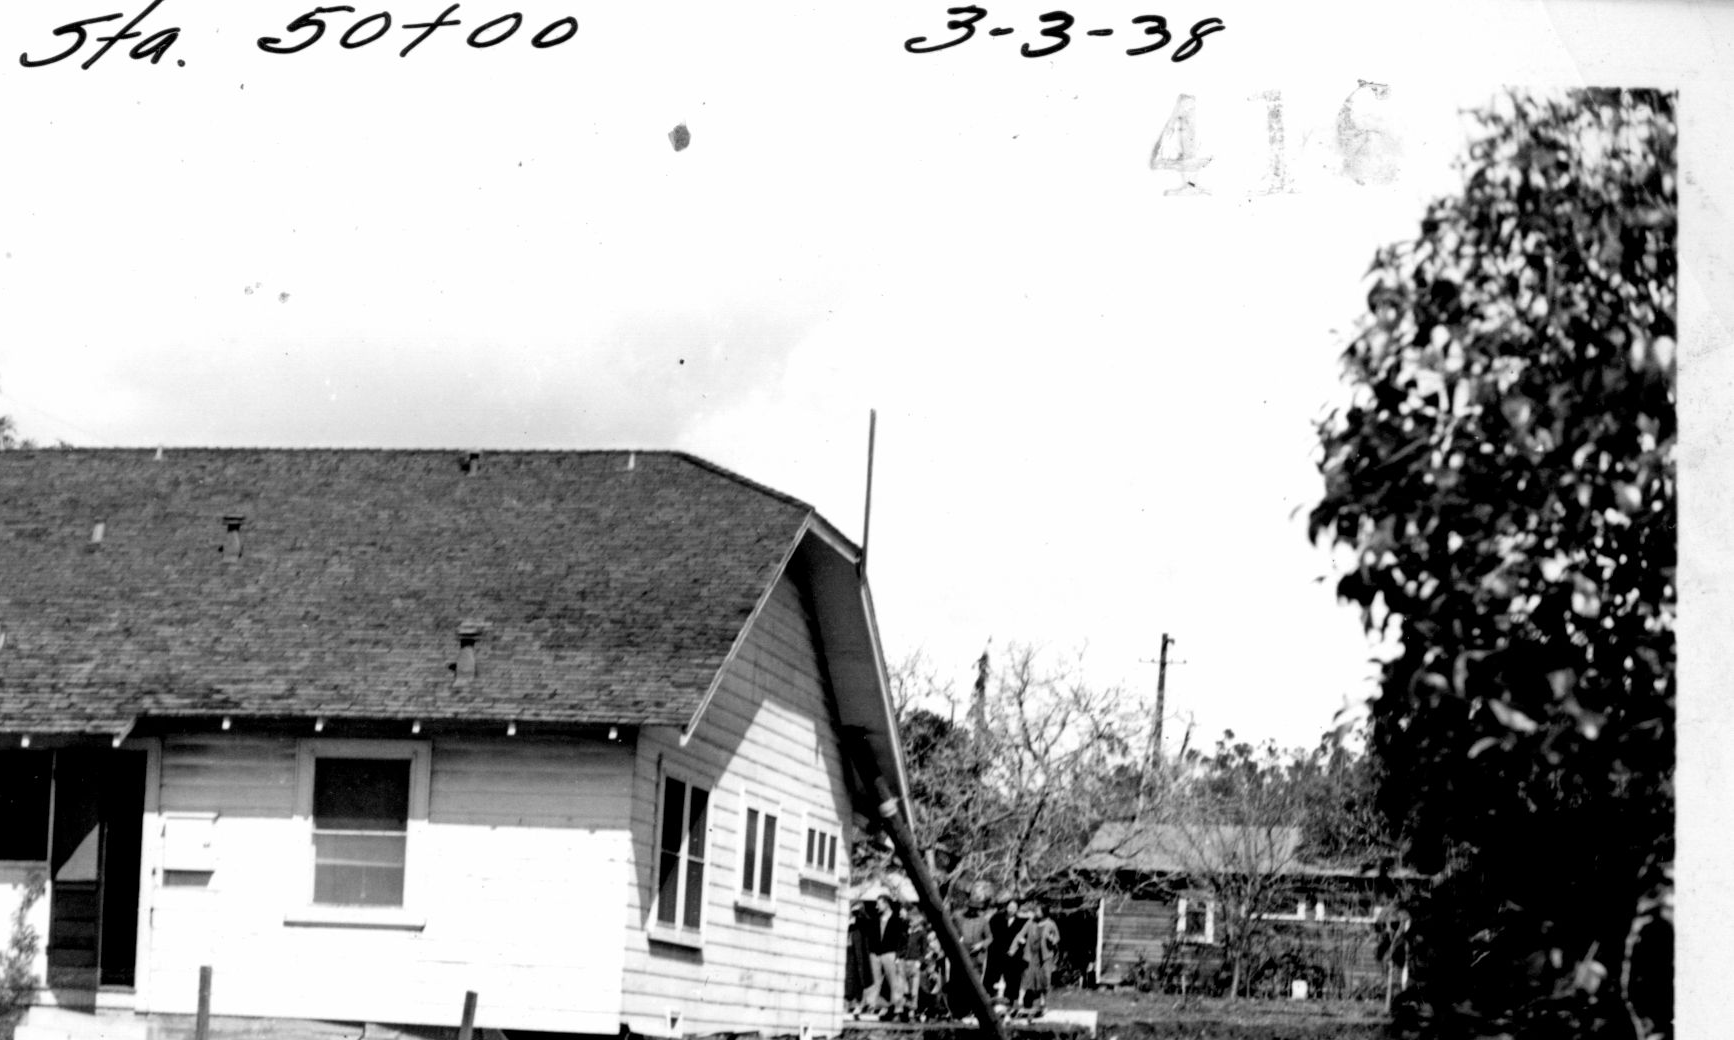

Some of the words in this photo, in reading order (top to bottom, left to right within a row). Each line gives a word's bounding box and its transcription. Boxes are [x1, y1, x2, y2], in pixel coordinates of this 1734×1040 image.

[19, 0, 186, 71] Sta.
[256, 3, 579, 58] 50+00
[903, 4, 1227, 63] 3-3-38
